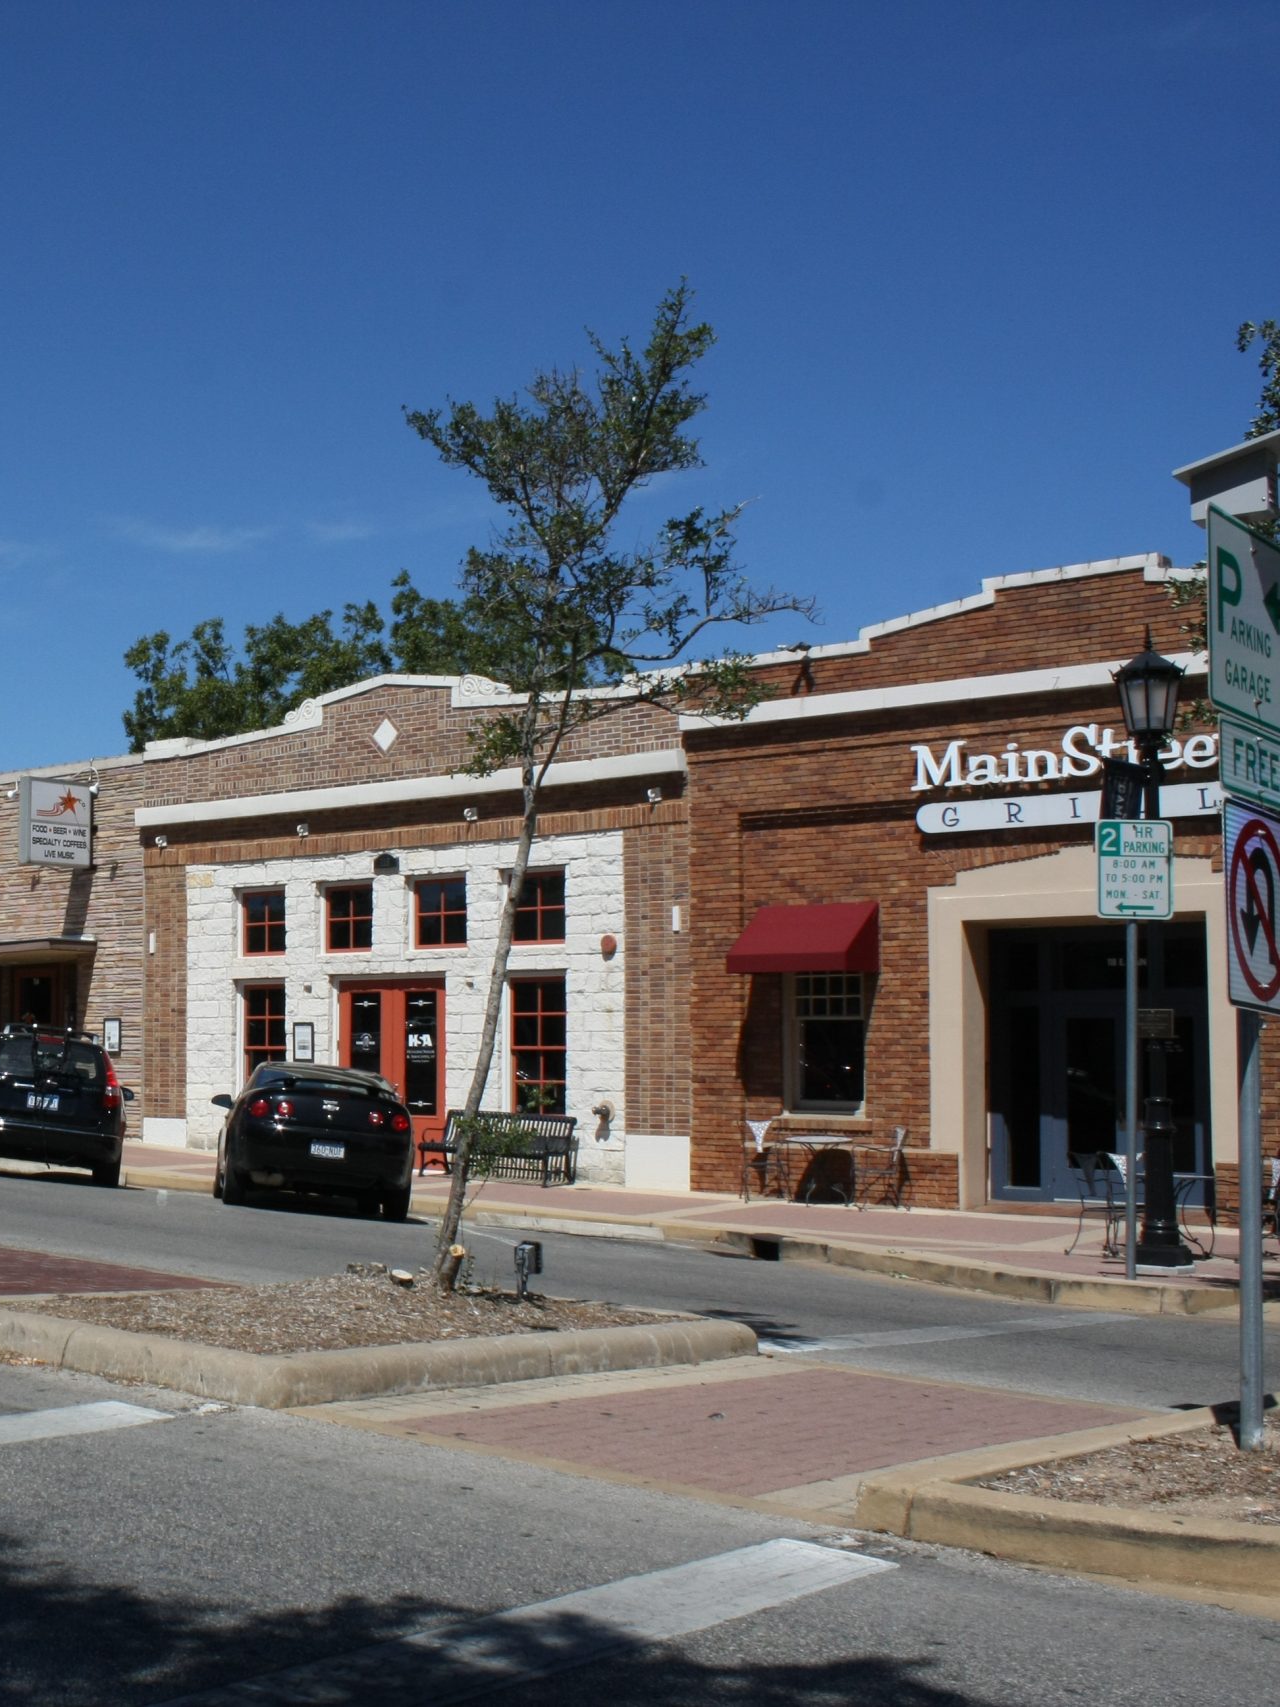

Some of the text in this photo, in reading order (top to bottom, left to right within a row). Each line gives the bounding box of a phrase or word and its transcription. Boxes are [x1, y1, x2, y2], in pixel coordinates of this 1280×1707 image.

[1225, 658, 1271, 703] GARAGE
[910, 723, 1219, 792] MainStree
[1233, 737, 1280, 792] FREE
[941, 787, 1217, 828] GRIL
[32, 824, 87, 838] FOOD BEER WINE
[31, 836, 88, 850] SPECIALTY COFFEES
[1101, 826, 1154, 852] 2 HR
[1123, 841, 1166, 854] PARKING
[44, 849, 76, 861] LIVE MUSIC
[1112, 859, 1157, 869] 8:00 AM
[1105, 873, 1164, 885] TO 5:00 PM
[408, 1033, 433, 1047] HSA
